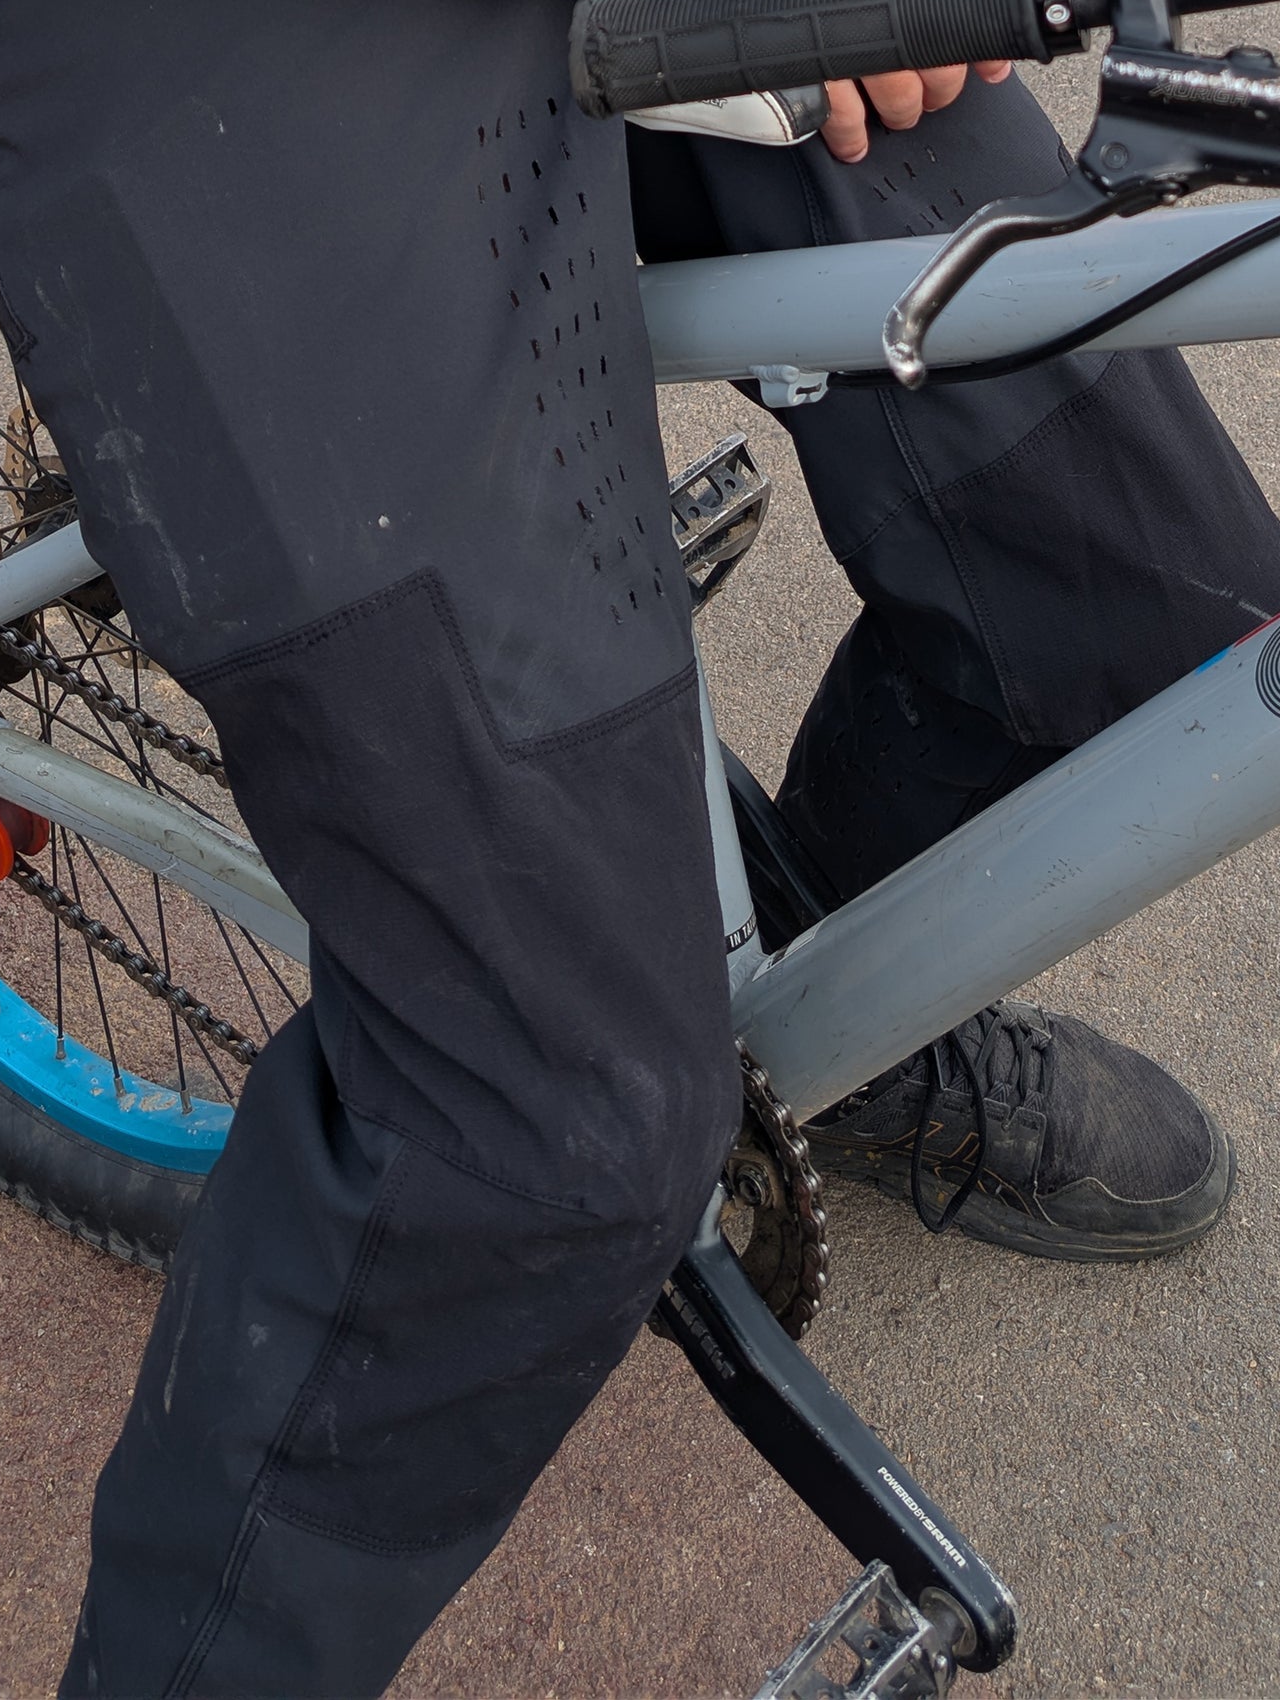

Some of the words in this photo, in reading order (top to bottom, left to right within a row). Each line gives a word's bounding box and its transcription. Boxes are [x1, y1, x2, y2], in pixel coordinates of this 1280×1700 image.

[877, 1466, 919, 1512] POWERED
[913, 1507, 928, 1521] BY
[922, 1518, 967, 1568] SRAM
